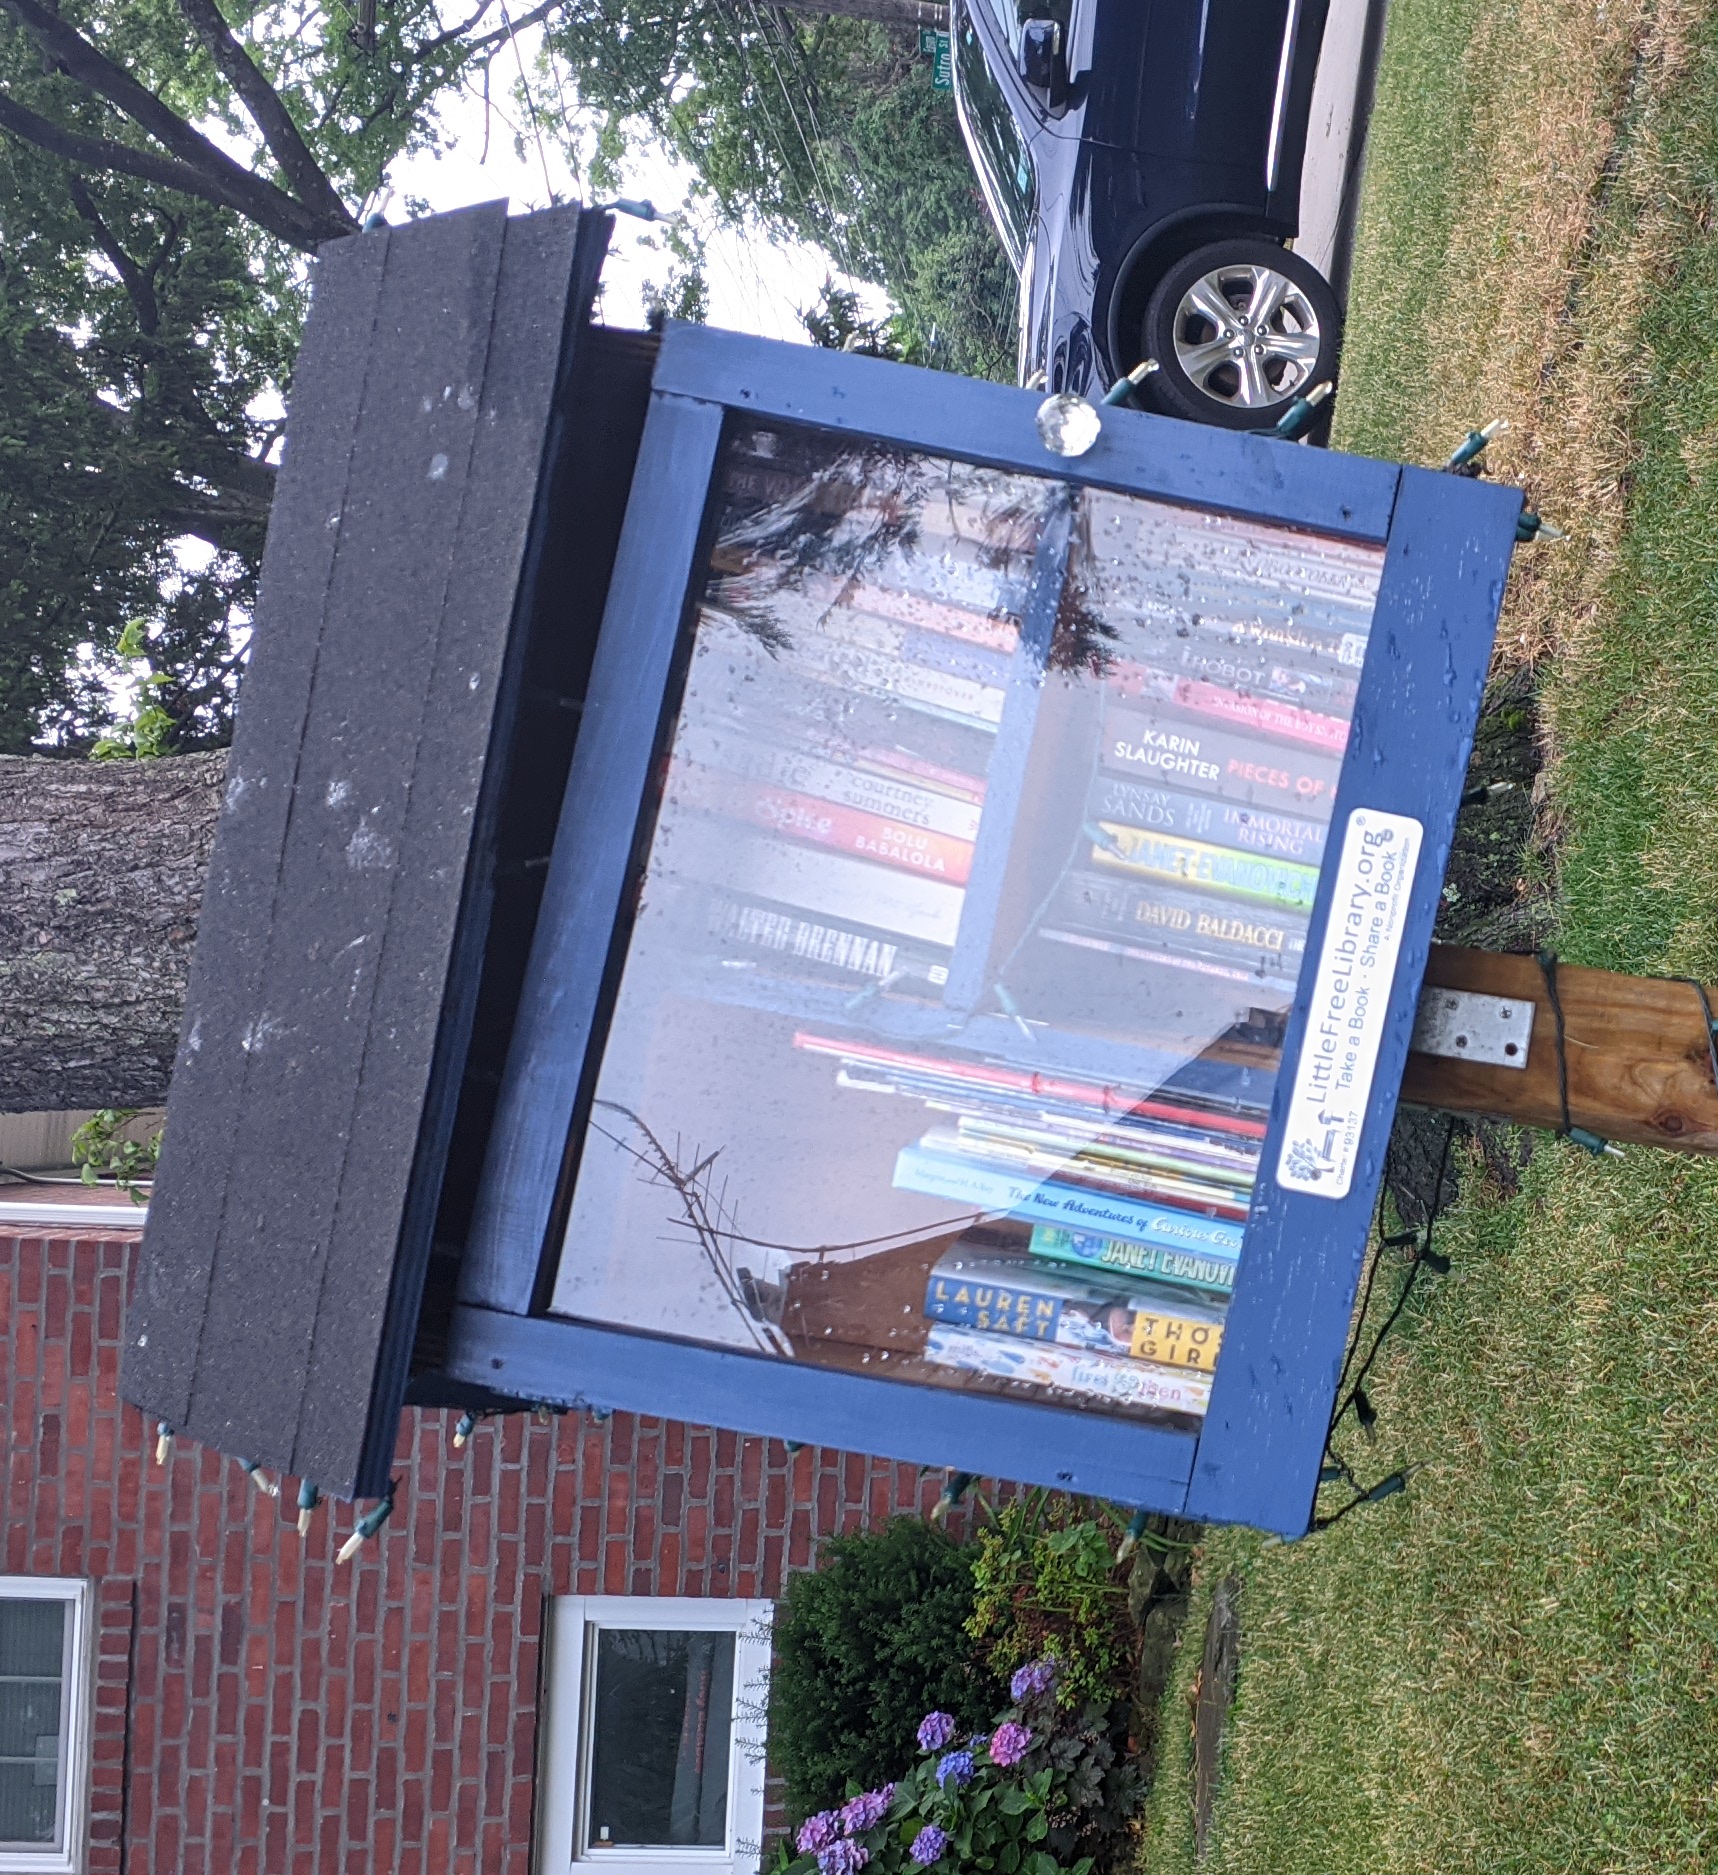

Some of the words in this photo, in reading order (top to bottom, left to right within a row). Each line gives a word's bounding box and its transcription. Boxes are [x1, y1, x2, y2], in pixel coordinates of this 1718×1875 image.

[935, 53, 951, 86] Sutro
[1143, 729, 1200, 756] KARIN
[1114, 741, 1220, 781] SLAUGHTER
[1226, 759, 1289, 789] PIECES
[1295, 776, 1324, 796] OF
[843, 789, 930, 826] summers
[852, 774, 934, 810] courtney
[1111, 783, 1172, 806] LYNSAY
[1102, 798, 1176, 827] SANDS
[1223, 807, 1323, 842] IMMORTAL
[855, 835, 946, 873] BABALOLA
[882, 826, 928, 851] BOLU
[1238, 827, 1304, 855] RISING
[1373, 849, 1398, 893] Book
[1136, 900, 1192, 930] DAVID
[1195, 914, 1286, 951] BALDACCI
[1373, 900, 1387, 919] a
[1359, 914, 1385, 969] Share
[1305, 829, 1384, 1104] LittleFreeLibrary.org
[1347, 988, 1370, 1030] Book
[1346, 1035, 1358, 1055] a
[1334, 1055, 1353, 1091] Take
[1007, 1186, 1030, 1203] The
[1032, 1190, 1059, 1209] New
[1061, 1199, 1135, 1225] Adventures
[1135, 1216, 1150, 1235] of
[1211, 1226, 1243, 1249] Geo
[1101, 1239, 1157, 1271] JANET
[934, 1280, 1056, 1317] LAUREN
[975, 1310, 1049, 1338] SAFT
